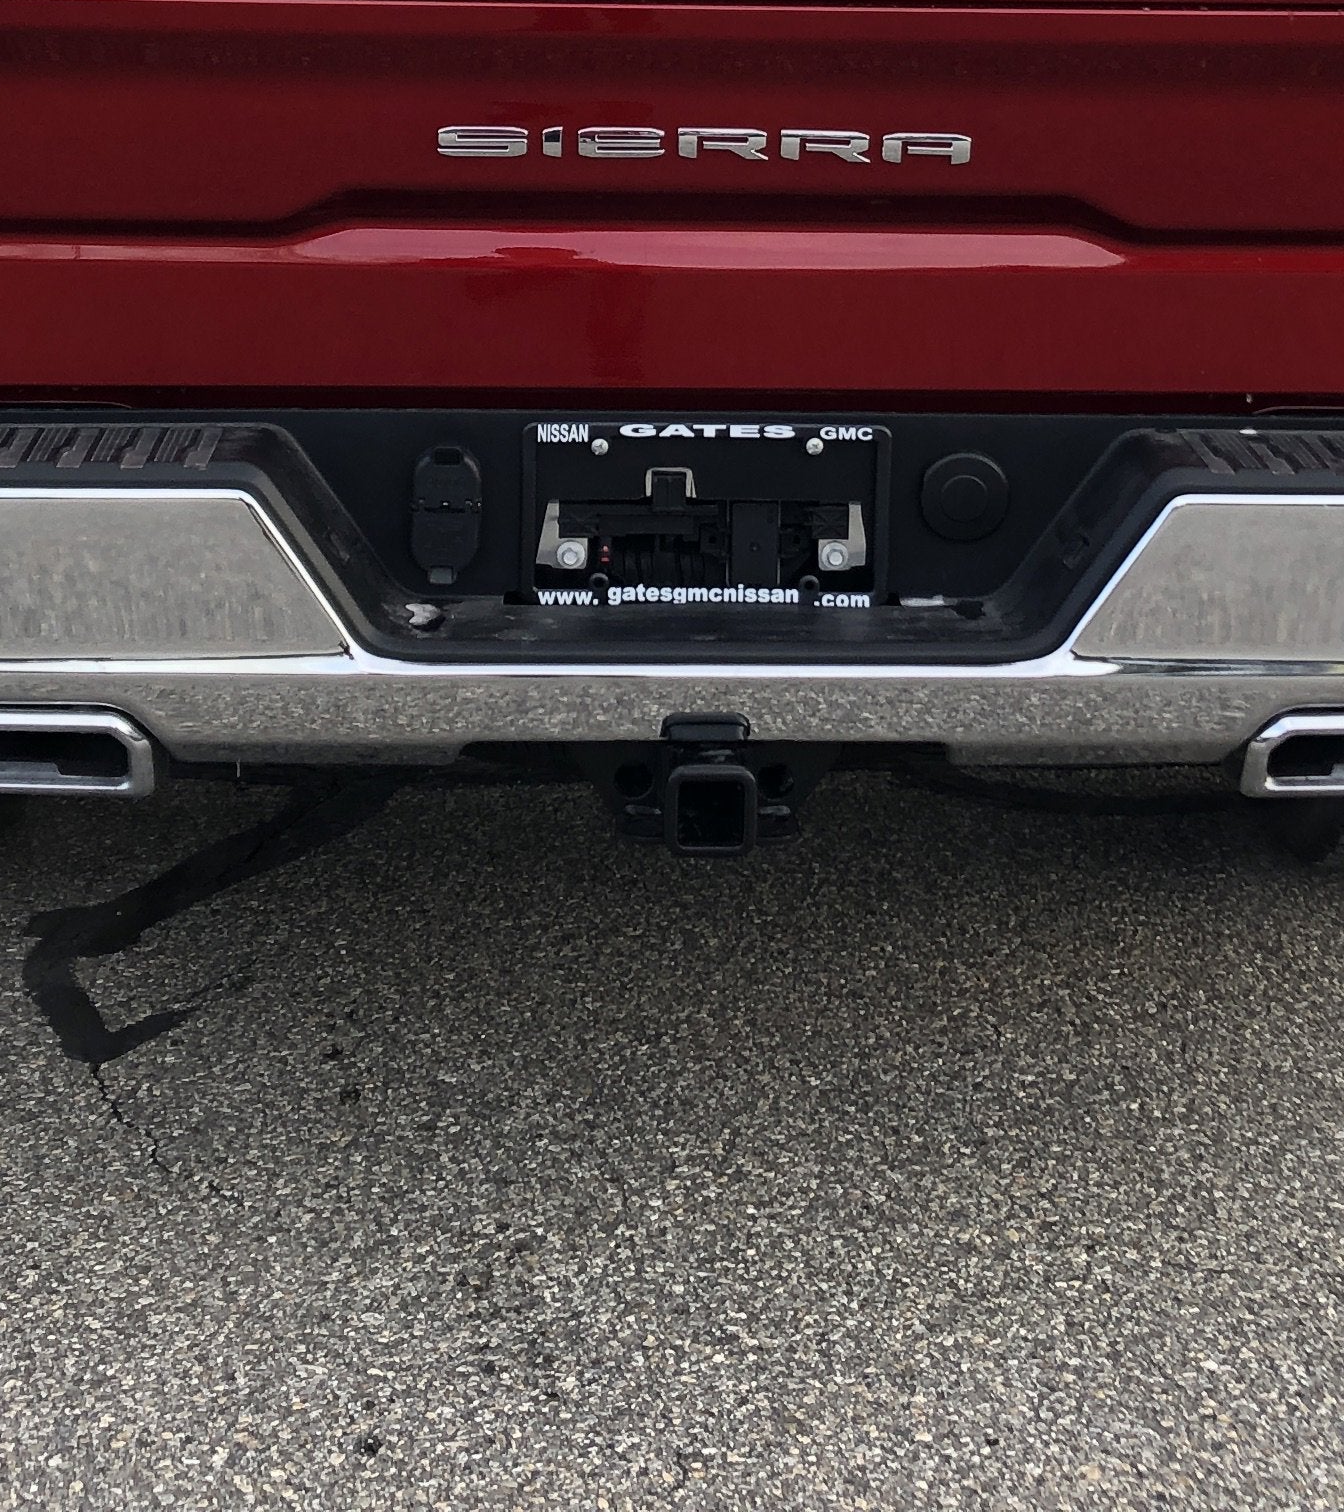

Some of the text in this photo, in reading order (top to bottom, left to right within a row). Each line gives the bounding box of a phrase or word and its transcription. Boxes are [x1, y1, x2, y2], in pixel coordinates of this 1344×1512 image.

[436, 125, 972, 165] SIERRA
[537, 424, 873, 443] NISSAN GATES GMC
[607, 584, 800, 605] gatesgmcnissan
